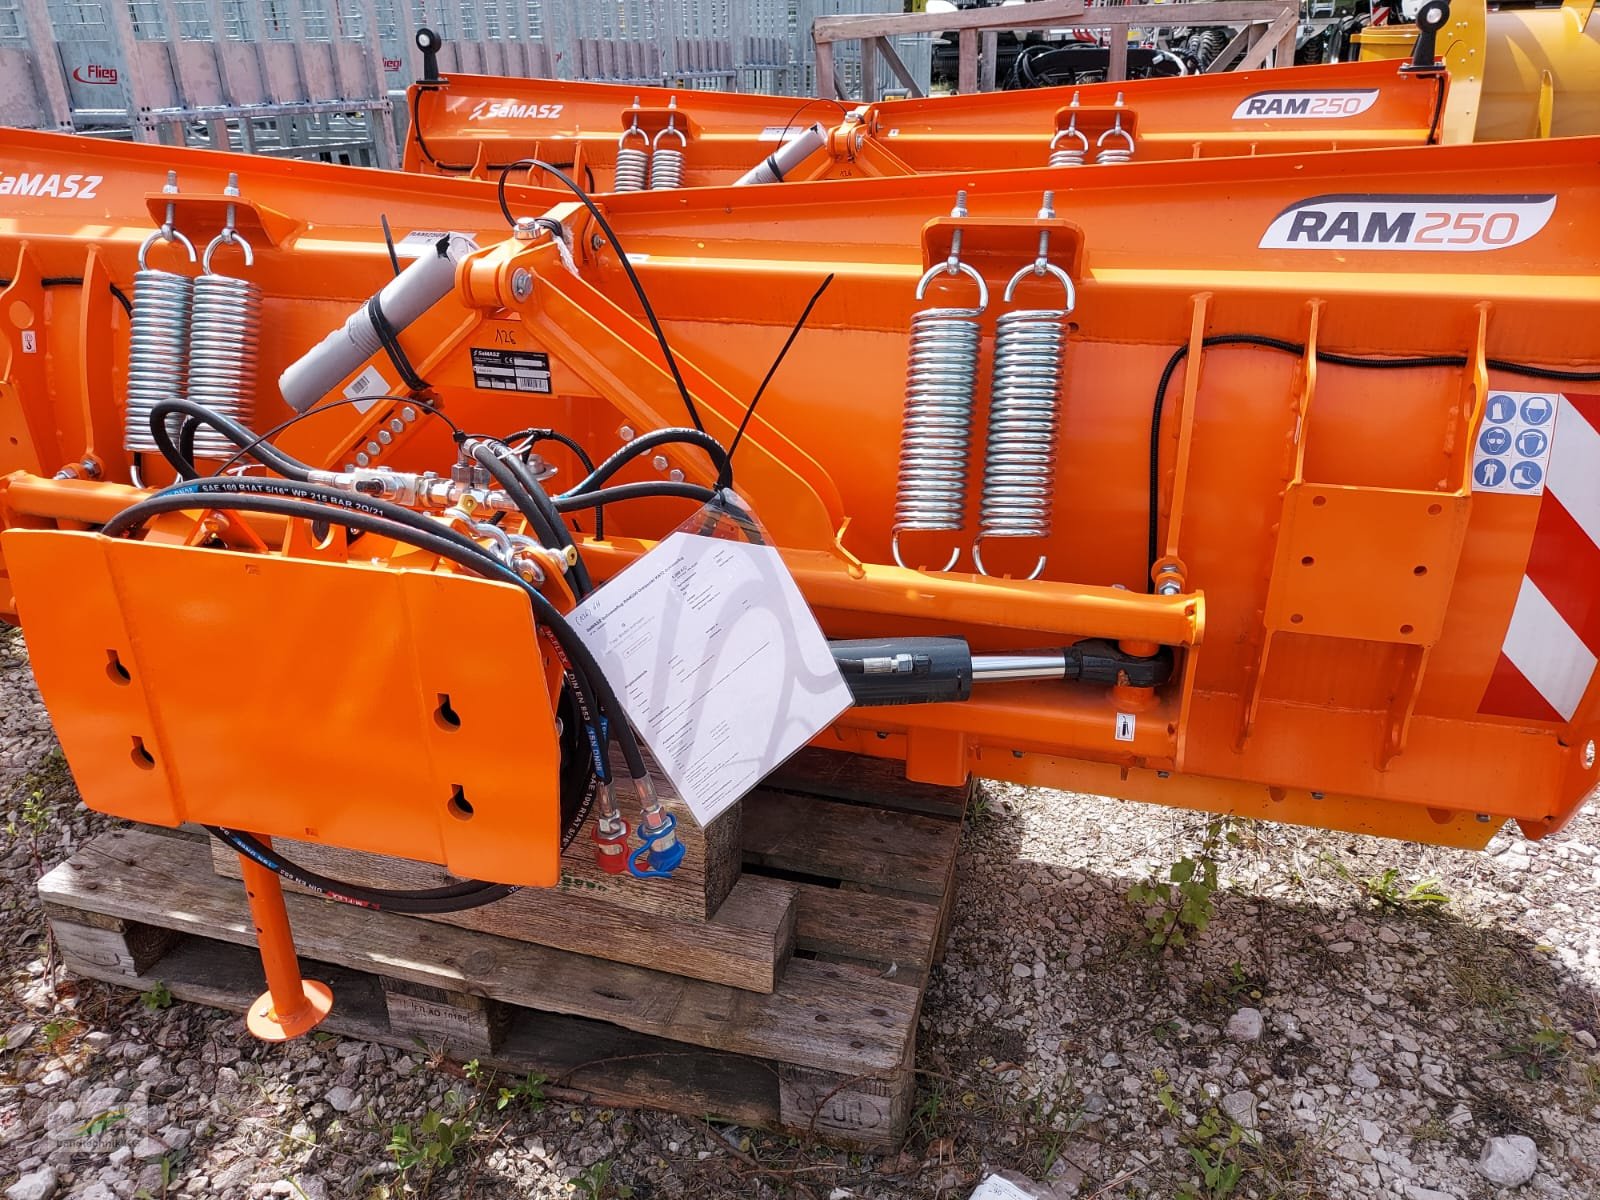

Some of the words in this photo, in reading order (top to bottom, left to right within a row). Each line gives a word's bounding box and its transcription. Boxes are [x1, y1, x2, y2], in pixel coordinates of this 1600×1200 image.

[487, 103, 564, 119] SaMASZ
[0, 173, 104, 199] aMASZ
[239, 484, 264, 493] R1AT
[291, 489, 308, 498] WP
[310, 492, 328, 502] 215
[330, 497, 353, 508] BAR
[567, 673, 580, 690] DIN
[575, 691, 585, 704] EN
